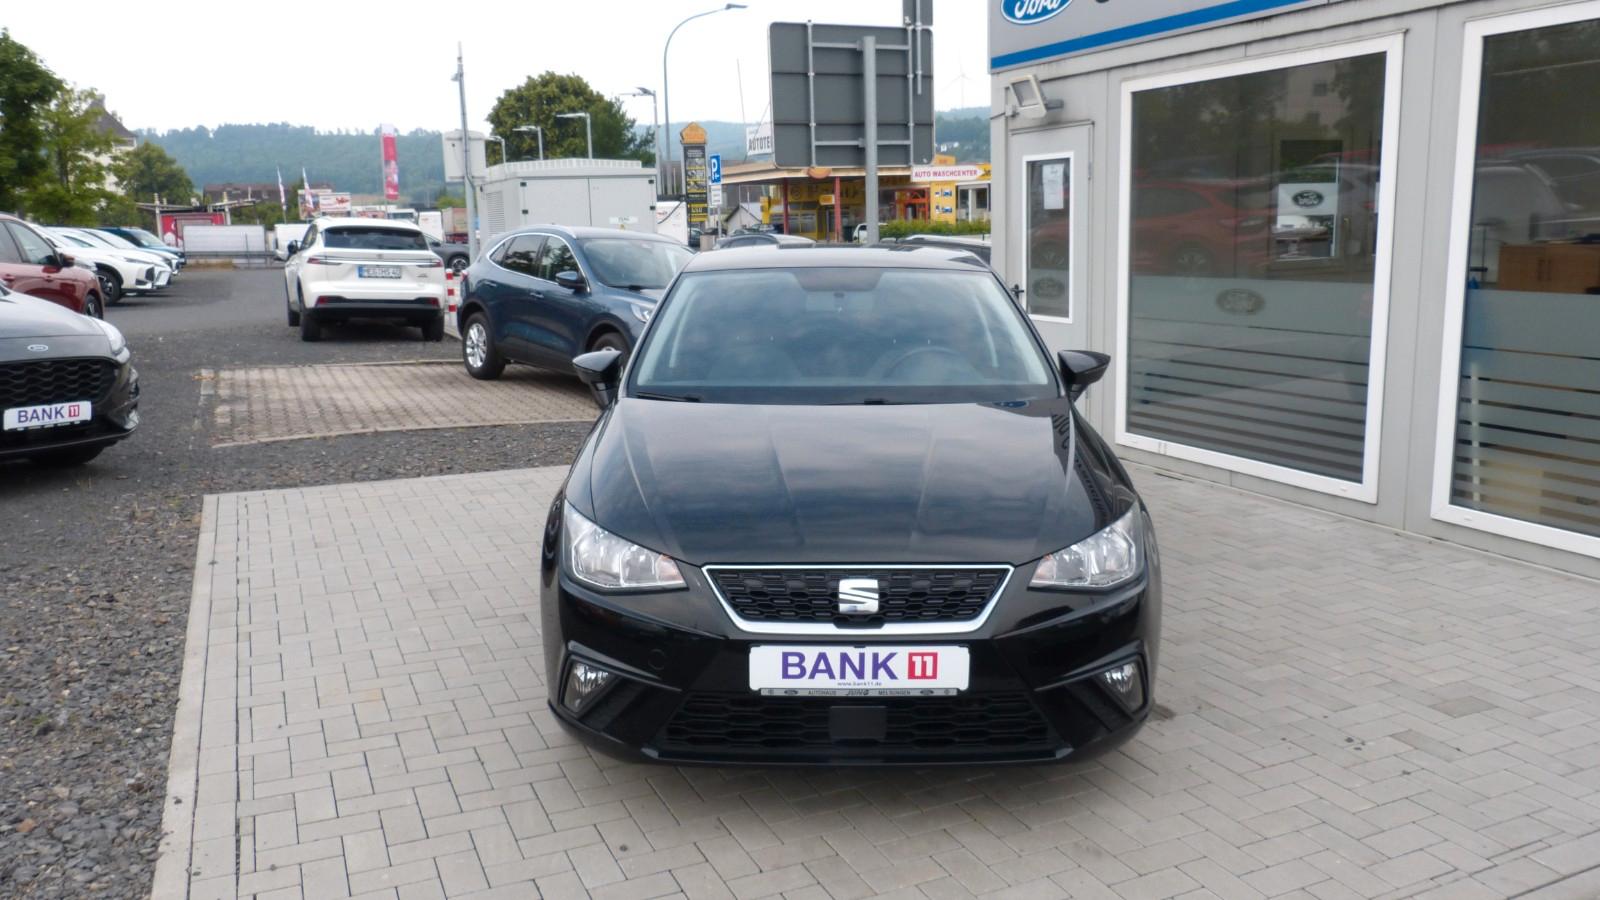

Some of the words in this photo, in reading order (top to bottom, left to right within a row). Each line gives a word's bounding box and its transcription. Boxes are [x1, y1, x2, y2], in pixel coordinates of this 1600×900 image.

[932, 169, 978, 177] WASCHCENTER
[17, 406, 65, 423] BANK
[69, 405, 79, 417] 11
[781, 651, 899, 680] BANK
[910, 654, 936, 678] 11
